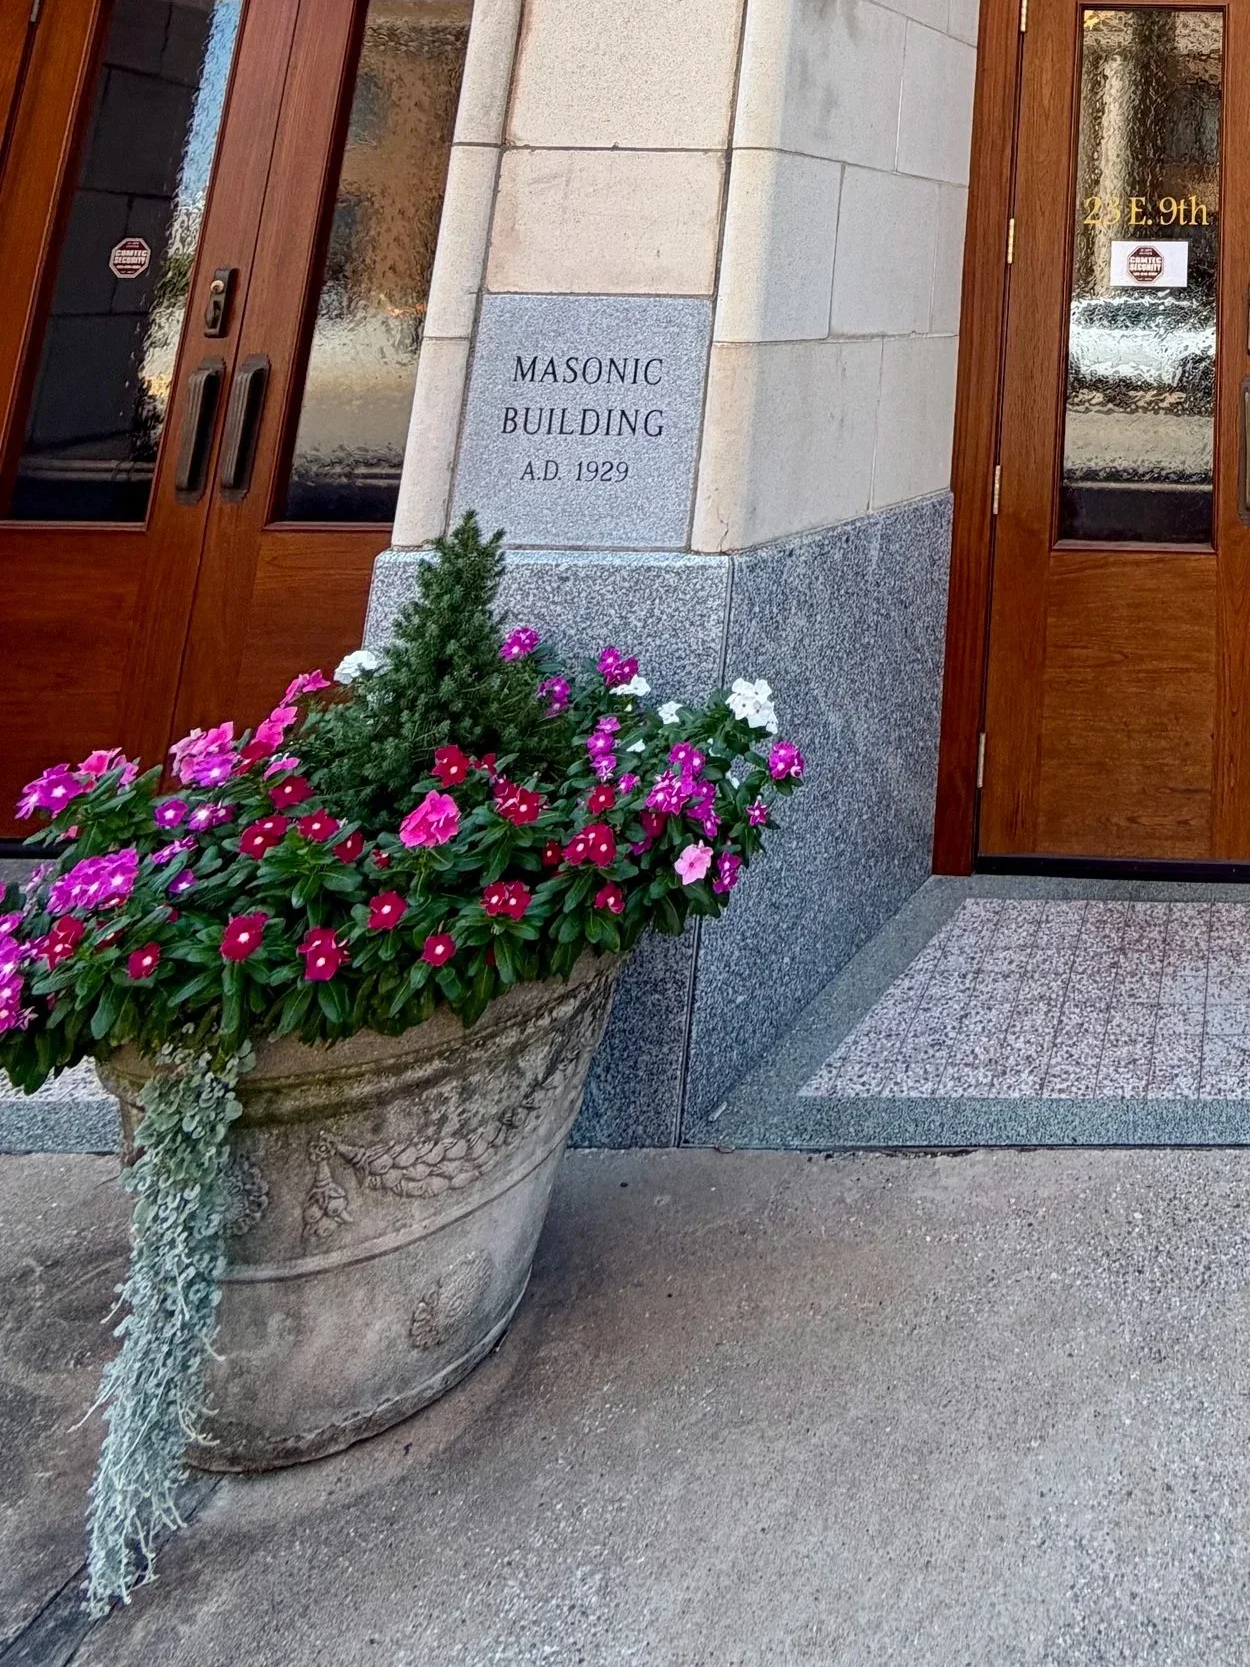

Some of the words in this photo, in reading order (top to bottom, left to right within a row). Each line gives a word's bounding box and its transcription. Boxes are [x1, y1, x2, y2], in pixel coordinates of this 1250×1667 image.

[1083, 196, 1122, 225] 23
[1129, 196, 1153, 226] E.
[1159, 195, 1210, 226] 9th
[113, 256, 146, 264] SECURITY
[115, 249, 148, 257] COMTEC
[1130, 256, 1162, 264] COMTEC
[1129, 264, 1162, 272] SECURITY
[512, 355, 663, 386] MASONIC
[501, 406, 665, 438] BUILDING
[520, 460, 562, 482] A.D.
[575, 460, 629, 483] 1929
